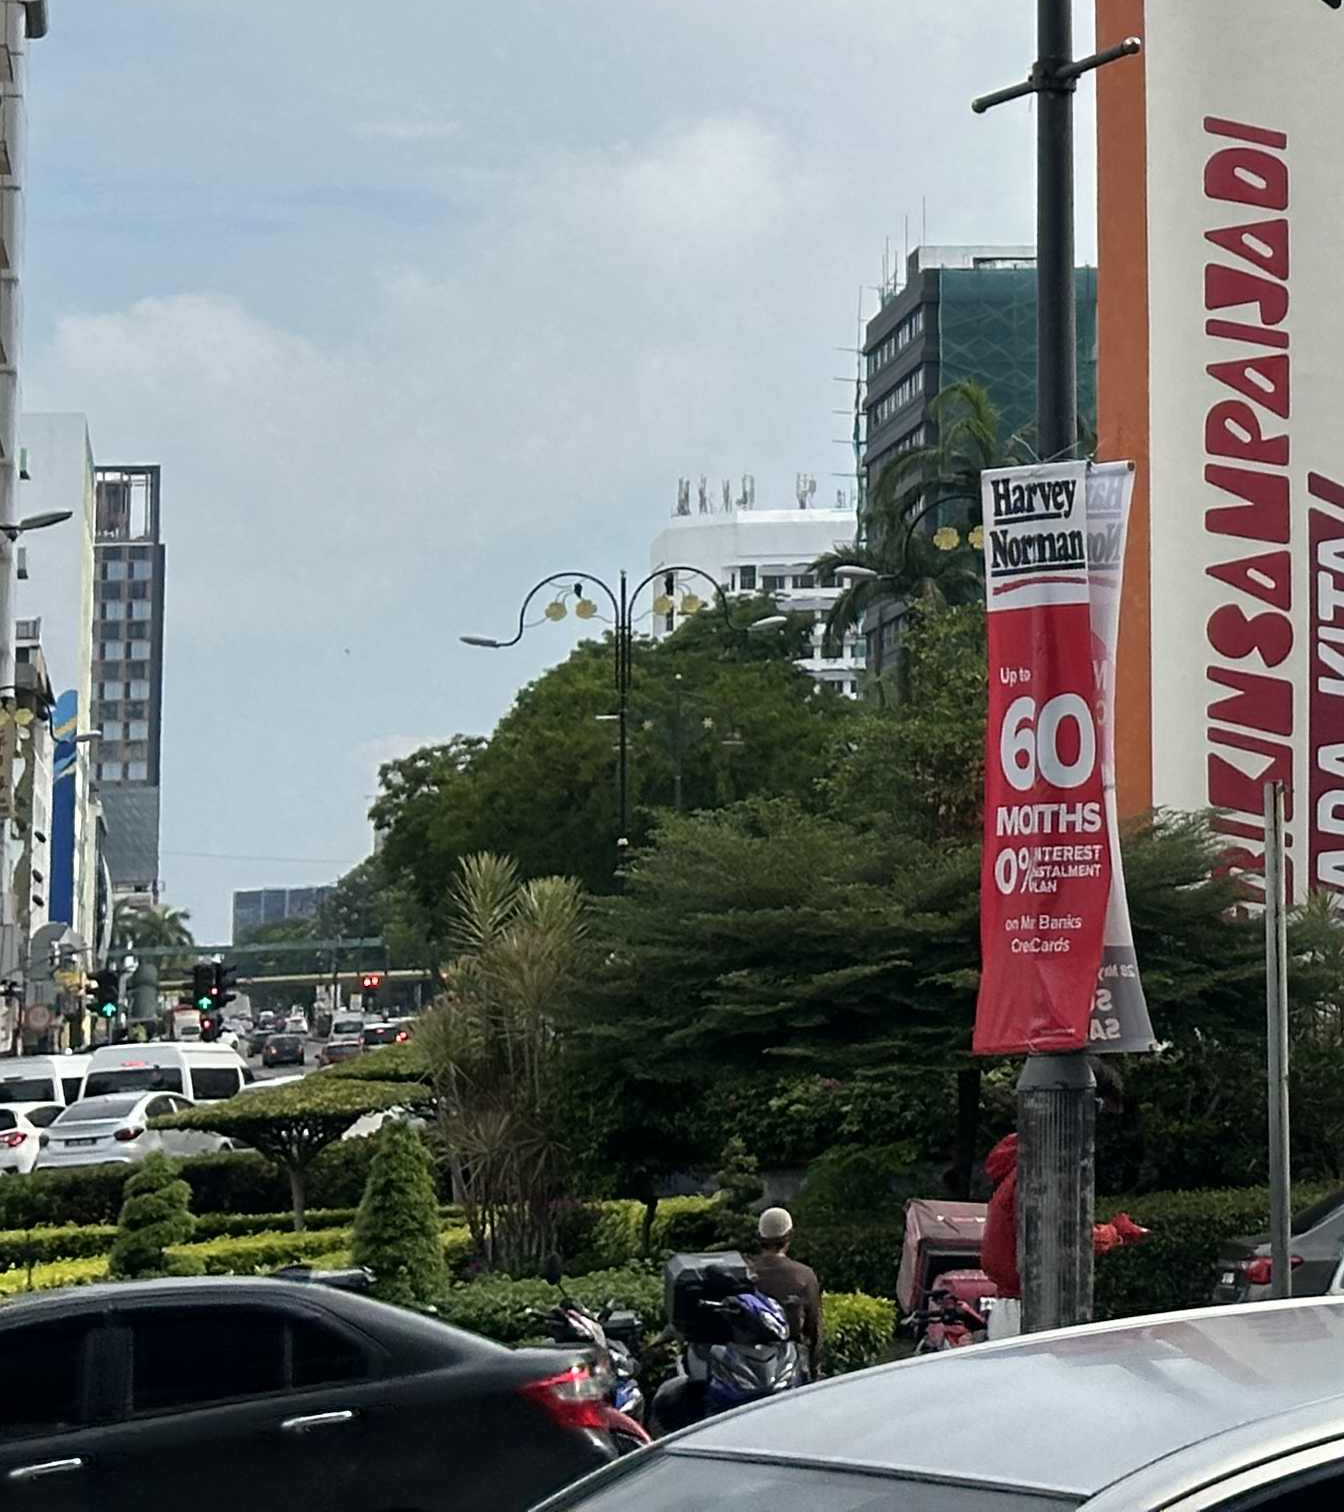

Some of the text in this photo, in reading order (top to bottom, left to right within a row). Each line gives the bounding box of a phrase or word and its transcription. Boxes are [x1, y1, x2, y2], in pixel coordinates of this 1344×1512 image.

[990, 478, 1077, 519] Harvey
[989, 529, 1086, 569] Norman
[1000, 667, 1032, 687] Up to
[1000, 692, 1096, 792] 60
[1038, 915, 1082, 931] Banks
